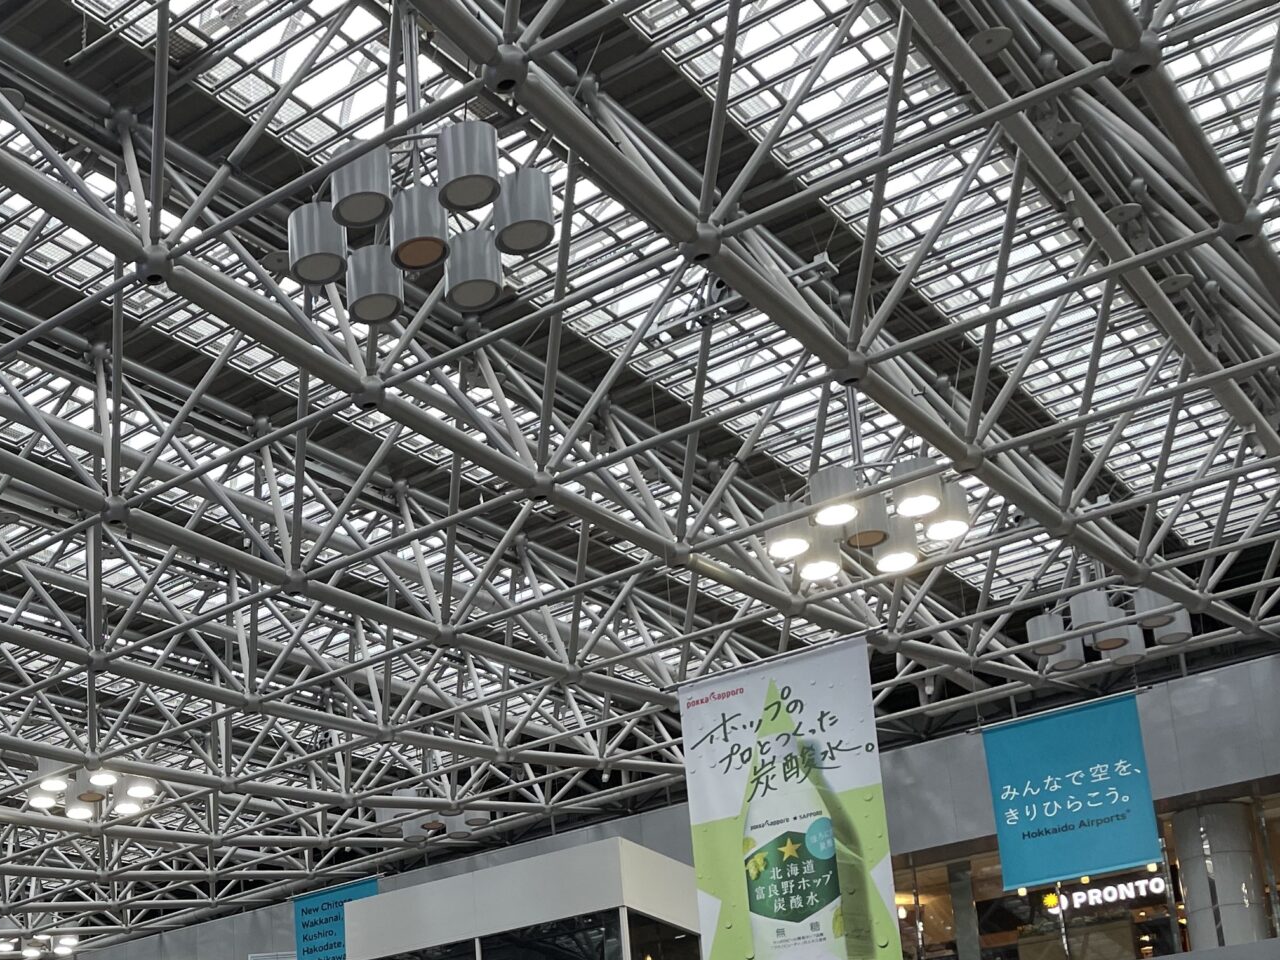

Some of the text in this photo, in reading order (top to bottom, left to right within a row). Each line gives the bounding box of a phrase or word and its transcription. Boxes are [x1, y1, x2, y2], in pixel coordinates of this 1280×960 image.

[690, 686, 804, 750] ホップの
[719, 710, 839, 774] プロとつくった
[747, 740, 874, 802] 炭酸水。
[1000, 759, 1142, 801] みんなで空を、
[1004, 787, 1130, 825] きりひらこう。
[1022, 822, 1076, 840] Hokkaido
[770, 859, 816, 880] 北海道
[754, 870, 833, 901] 富良野ホップ
[1072, 877, 1166, 909] PRONTO
[301, 898, 353, 917] New Chito
[773, 892, 820, 913] 炭酸水
[301, 913, 344, 929] Wakkanai,
[302, 929, 337, 943] Kushiro,
[302, 941, 345, 956] Hakodate,
